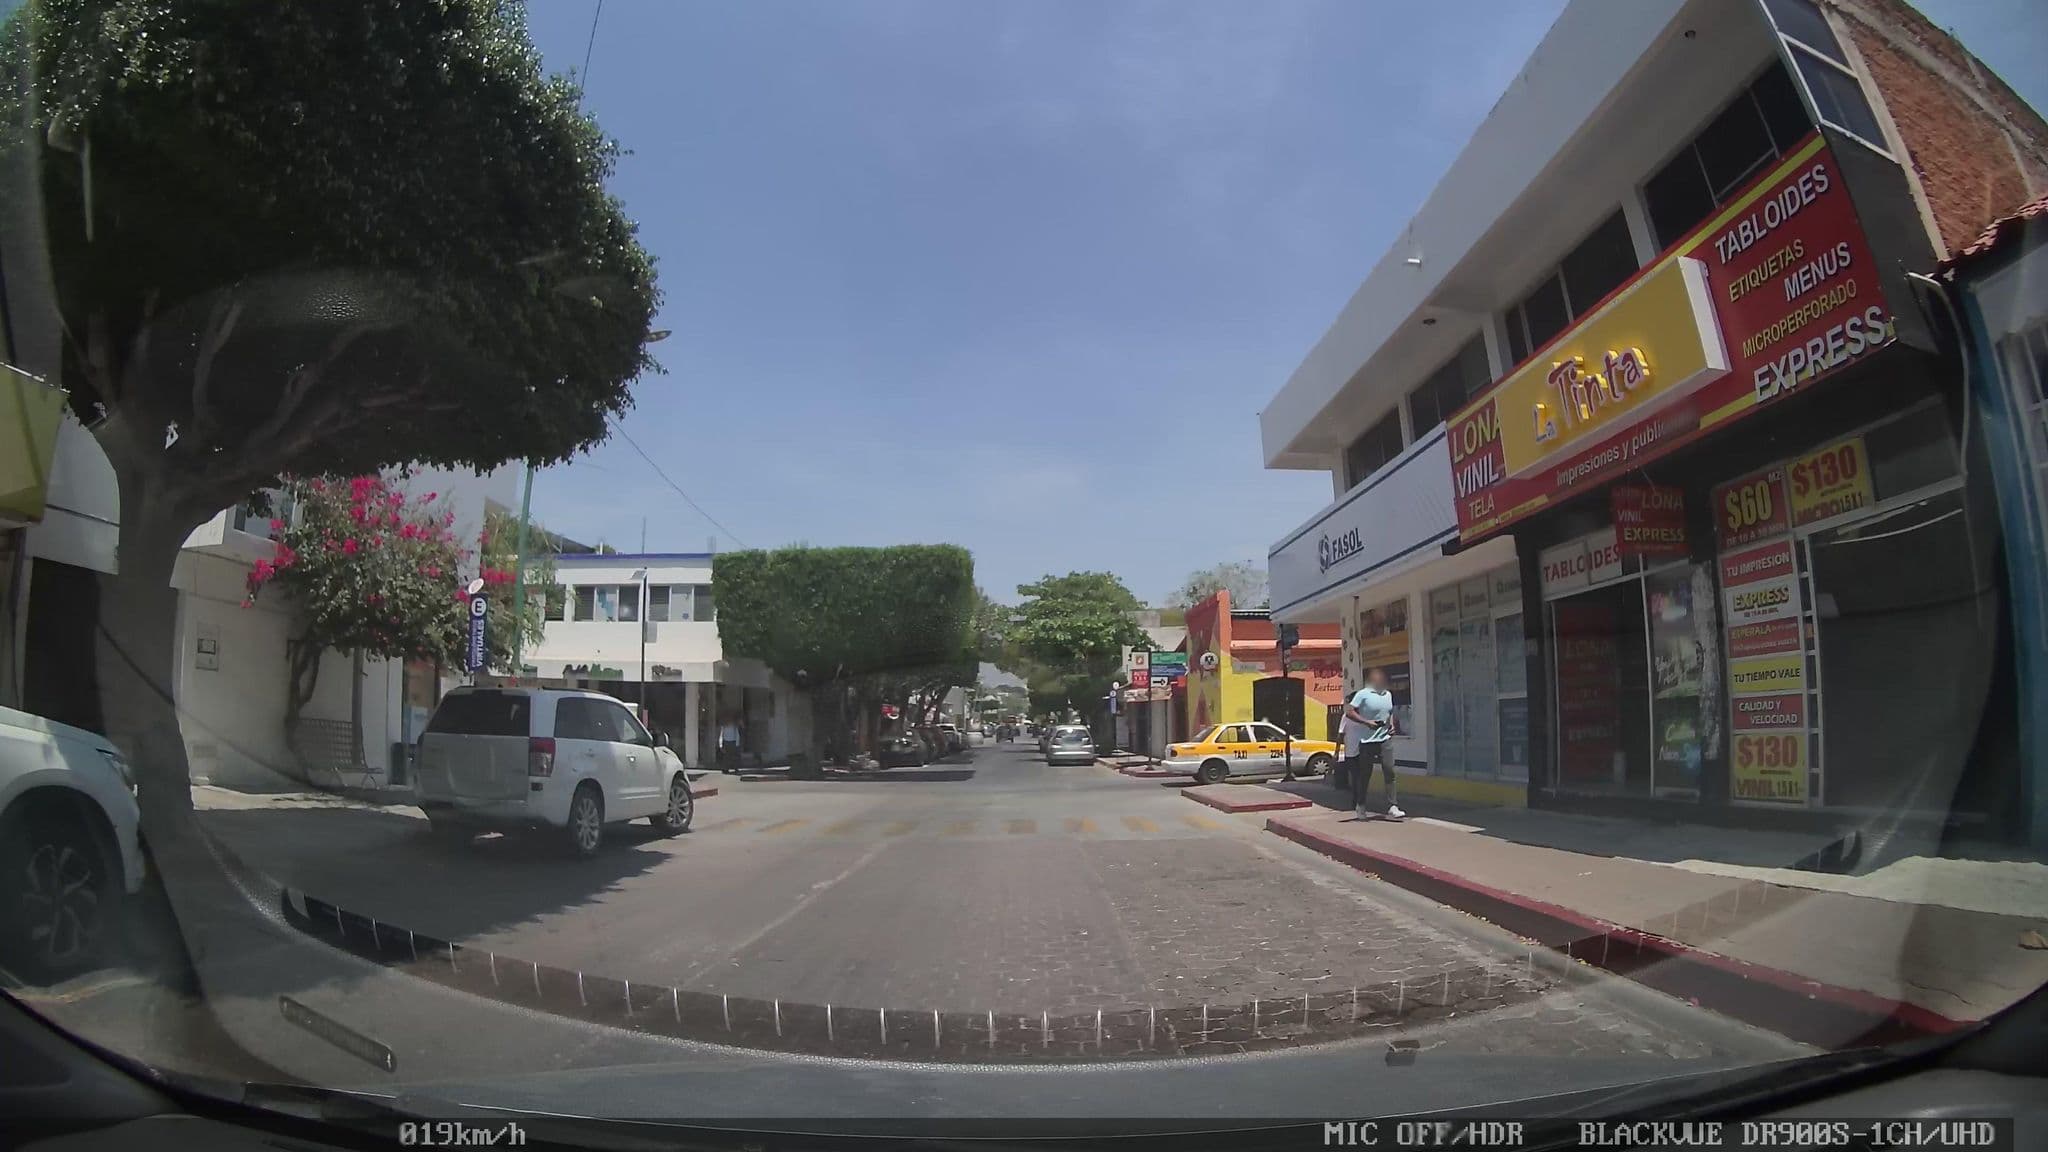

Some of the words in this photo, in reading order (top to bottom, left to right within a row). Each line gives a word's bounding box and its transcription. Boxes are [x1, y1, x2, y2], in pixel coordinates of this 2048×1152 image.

[1714, 164, 1830, 264] TABLOIDES
[1728, 238, 1804, 302] ETIQUETAS
[1783, 242, 1852, 302] MENUS
[1743, 279, 1857, 358] MICROPERFORADO
[1754, 305, 1888, 403] EXPRESS
[1547, 347, 1650, 428] Tinta
[1453, 406, 1503, 463] LONA
[1456, 452, 1499, 498] VINIL
[1556, 445, 1620, 486] Impresiones
[1621, 441, 1630, 460] y
[1791, 445, 1858, 497] $130
[1468, 493, 1495, 520] TELA
[1617, 510, 1645, 522] VINIL
[1642, 492, 1684, 511] LONA
[1726, 480, 1772, 532] $60
[1332, 528, 1363, 560] FASOL
[1624, 528, 1685, 542] EXPRESS
[1726, 567, 1738, 577] TU
[1740, 552, 1790, 574] IMPRESION
[1733, 588, 1789, 611] EXPRESS
[476, 619, 485, 666] VIRTUALES
[1734, 674, 1745, 683] TU
[1745, 670, 1776, 682] TIEMPO
[1778, 668, 1801, 679] VALE
[1739, 700, 1774, 711] CALIDAD
[1775, 700, 1782, 710] Y
[1750, 713, 1798, 724] VELOCIDAD
[1233, 749, 1248, 759] TAXI
[1738, 735, 1798, 768] $130
